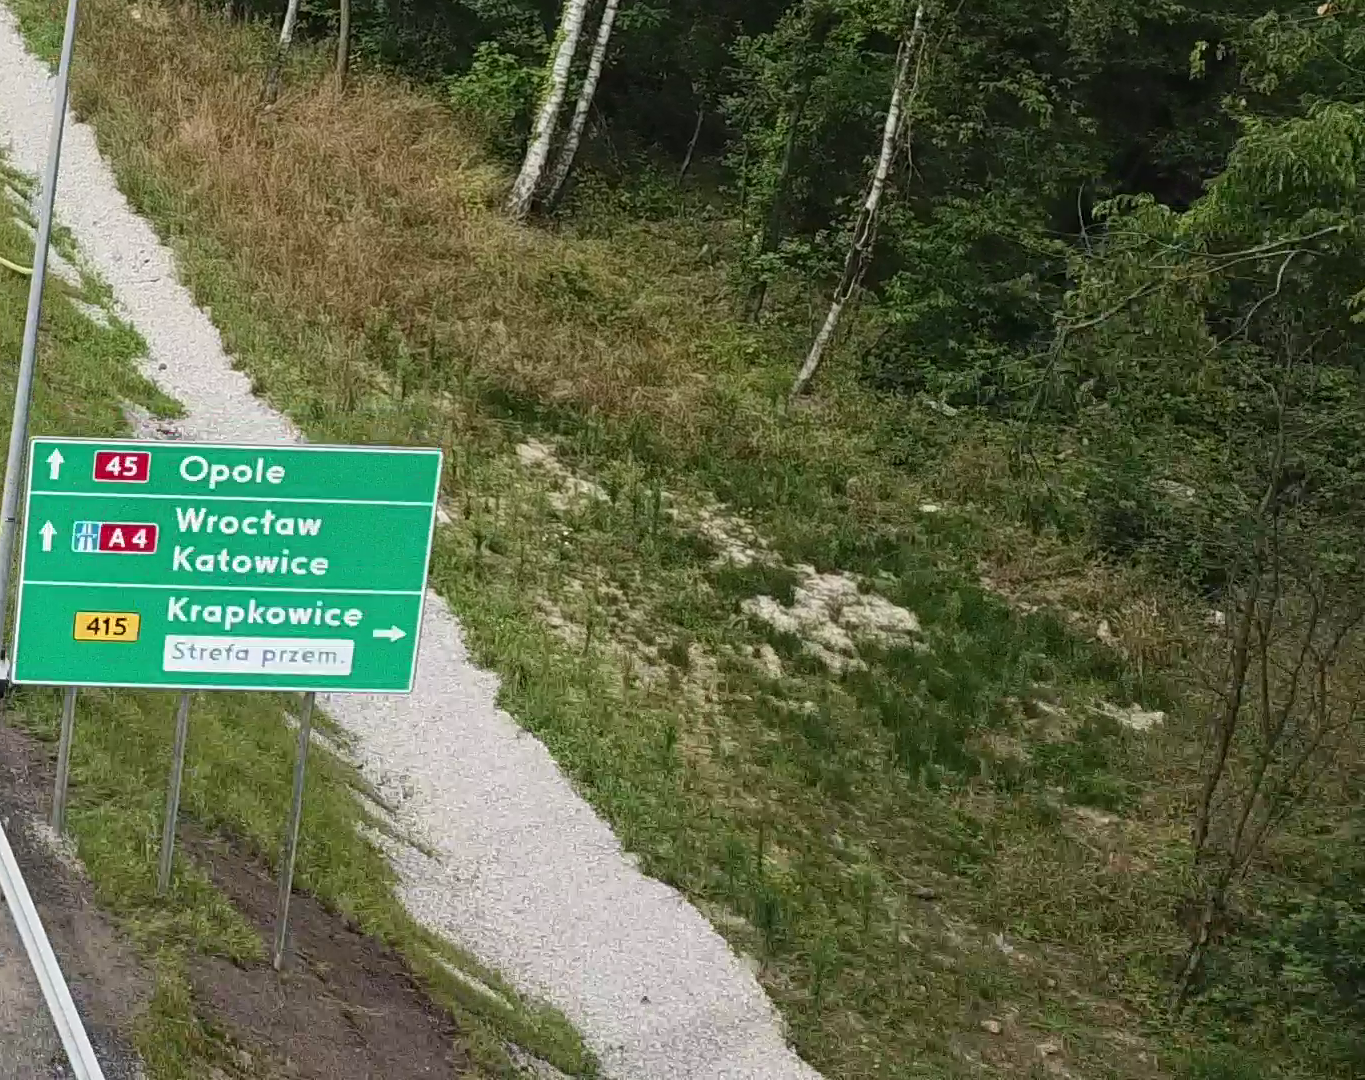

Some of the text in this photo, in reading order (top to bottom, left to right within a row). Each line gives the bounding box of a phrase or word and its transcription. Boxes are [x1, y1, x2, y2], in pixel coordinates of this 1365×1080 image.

[105, 456, 138, 477] 45
[179, 456, 286, 489] Opole
[175, 507, 322, 537] Wrocław
[172, 546, 330, 576] Katowice
[167, 597, 363, 631] Krapkowice
[86, 618, 127, 637] 415
[171, 642, 250, 662] Strefa
[262, 647, 346, 667] przem.
